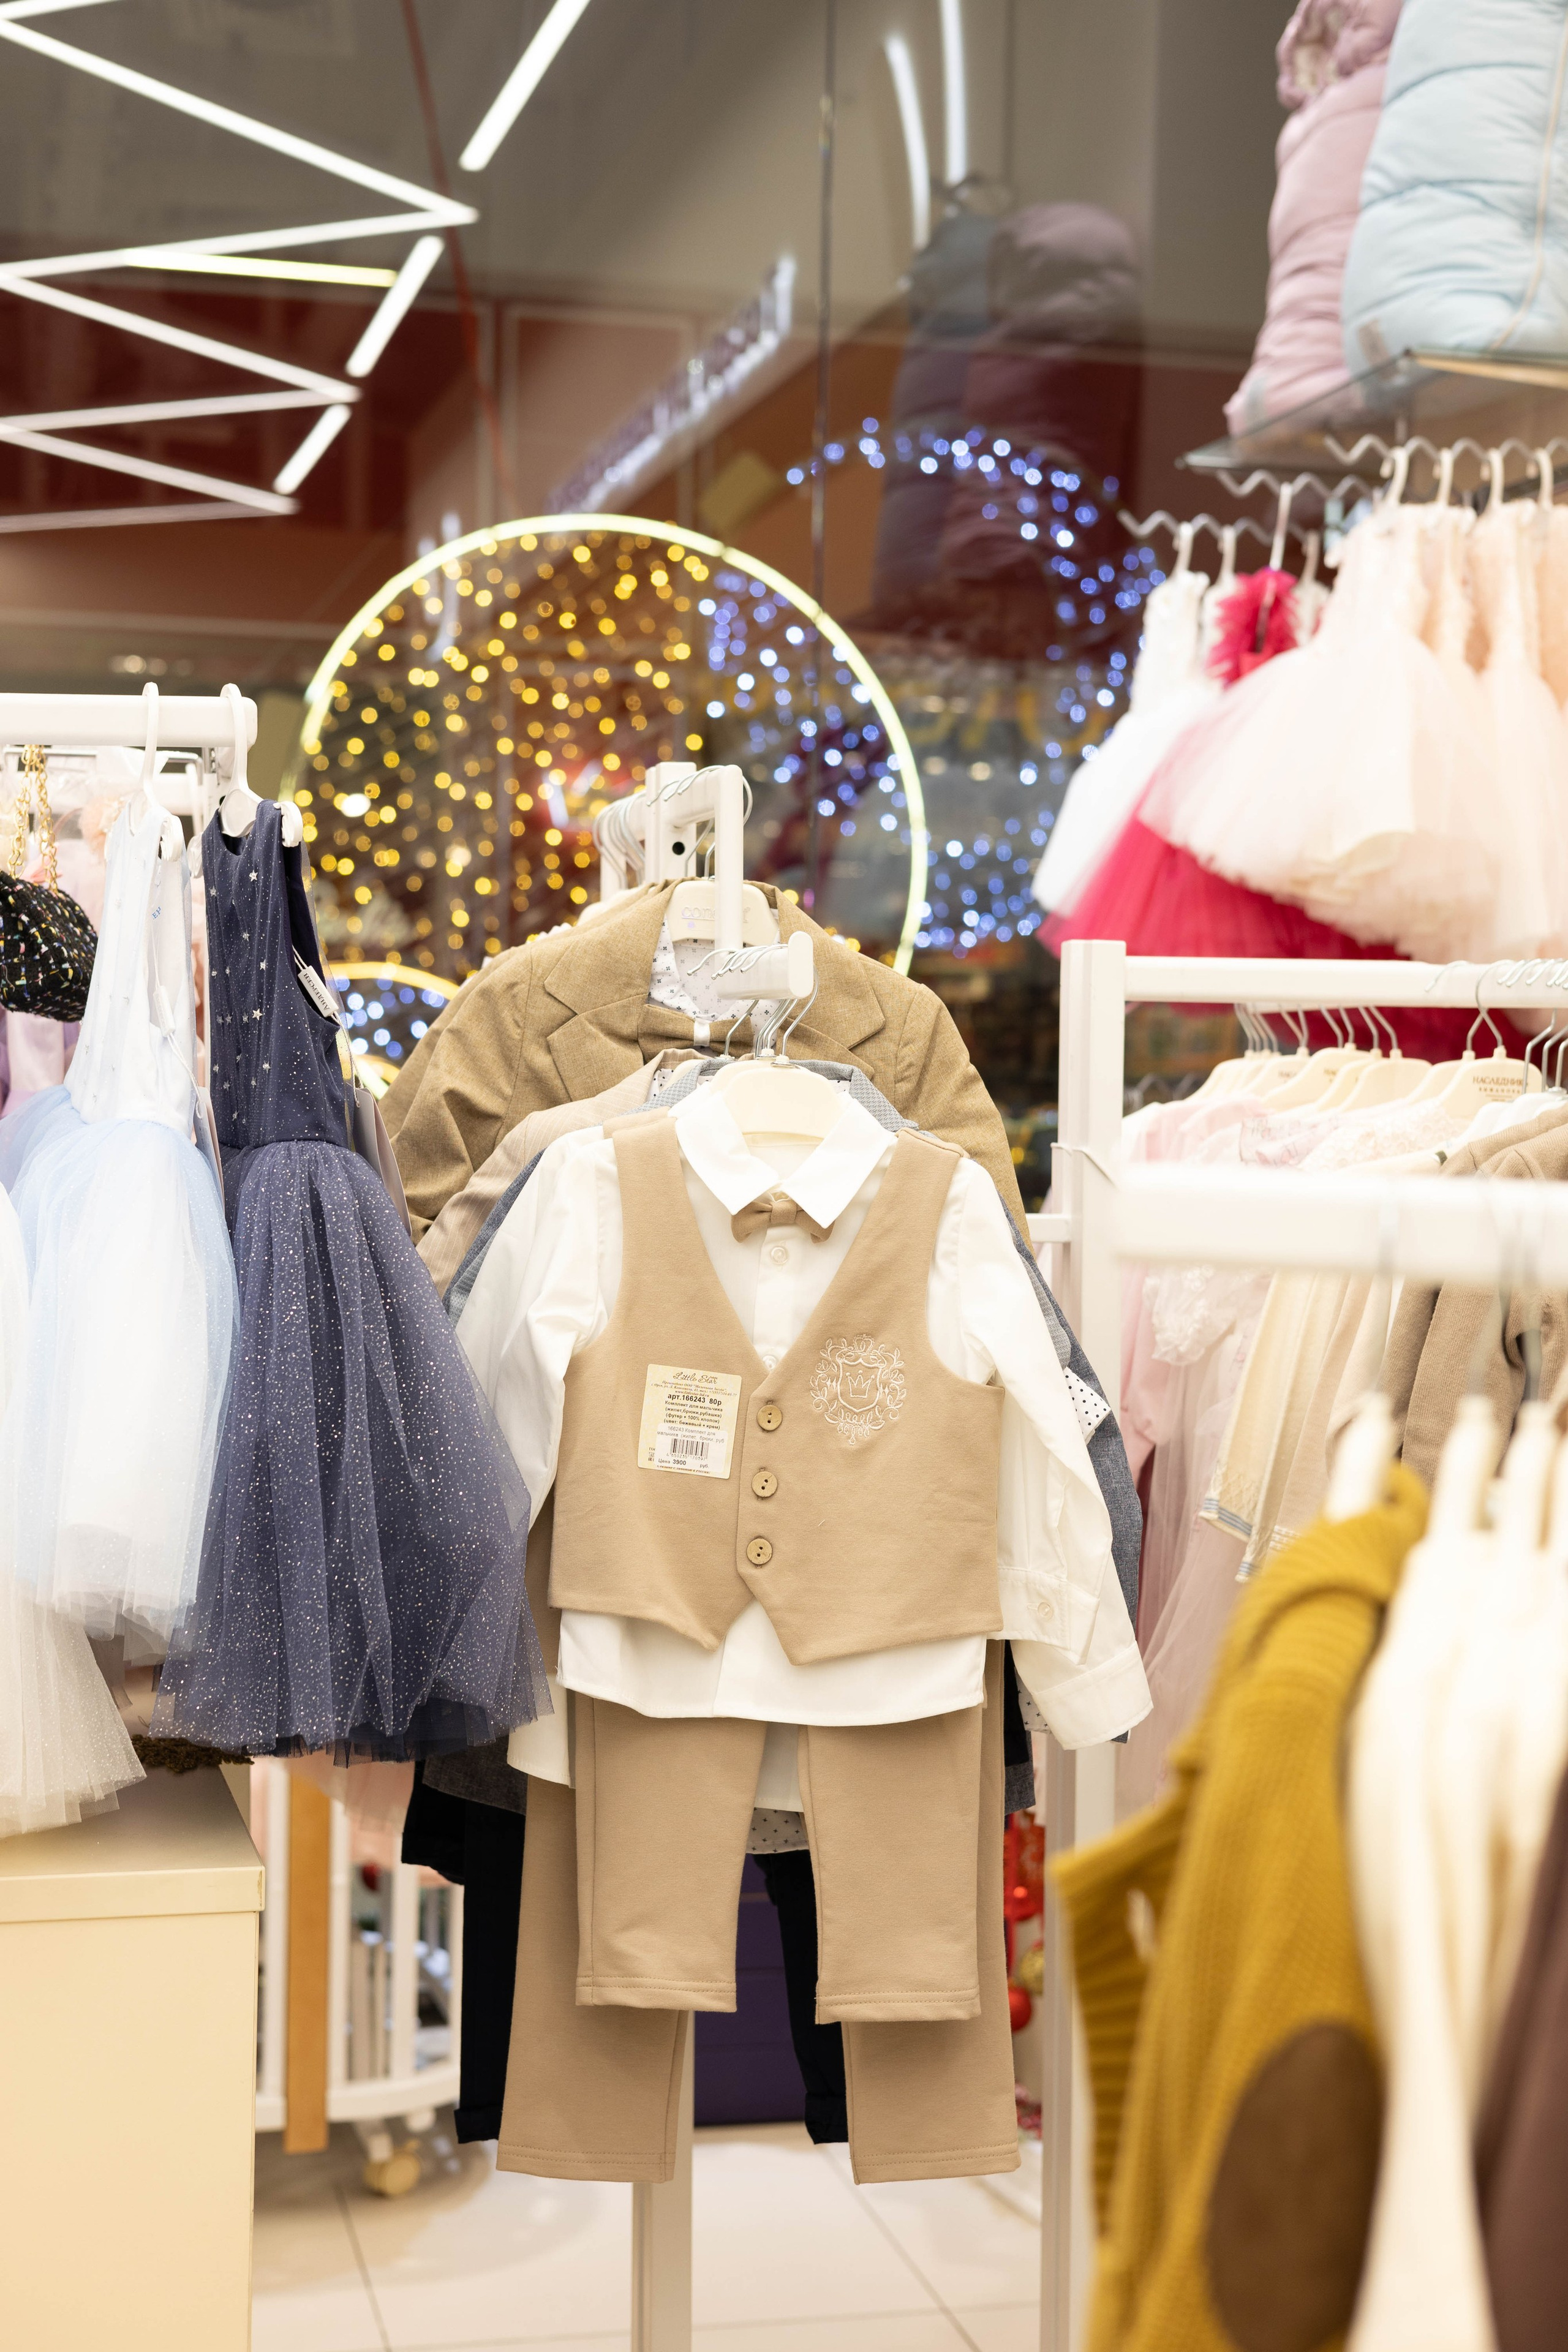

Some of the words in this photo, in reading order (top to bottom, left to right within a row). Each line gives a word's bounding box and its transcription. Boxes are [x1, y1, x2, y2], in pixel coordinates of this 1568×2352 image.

[673, 1371, 696, 1381] Little
[698, 1375, 717, 1384] Star
[668, 1394, 706, 1403] арт.166243
